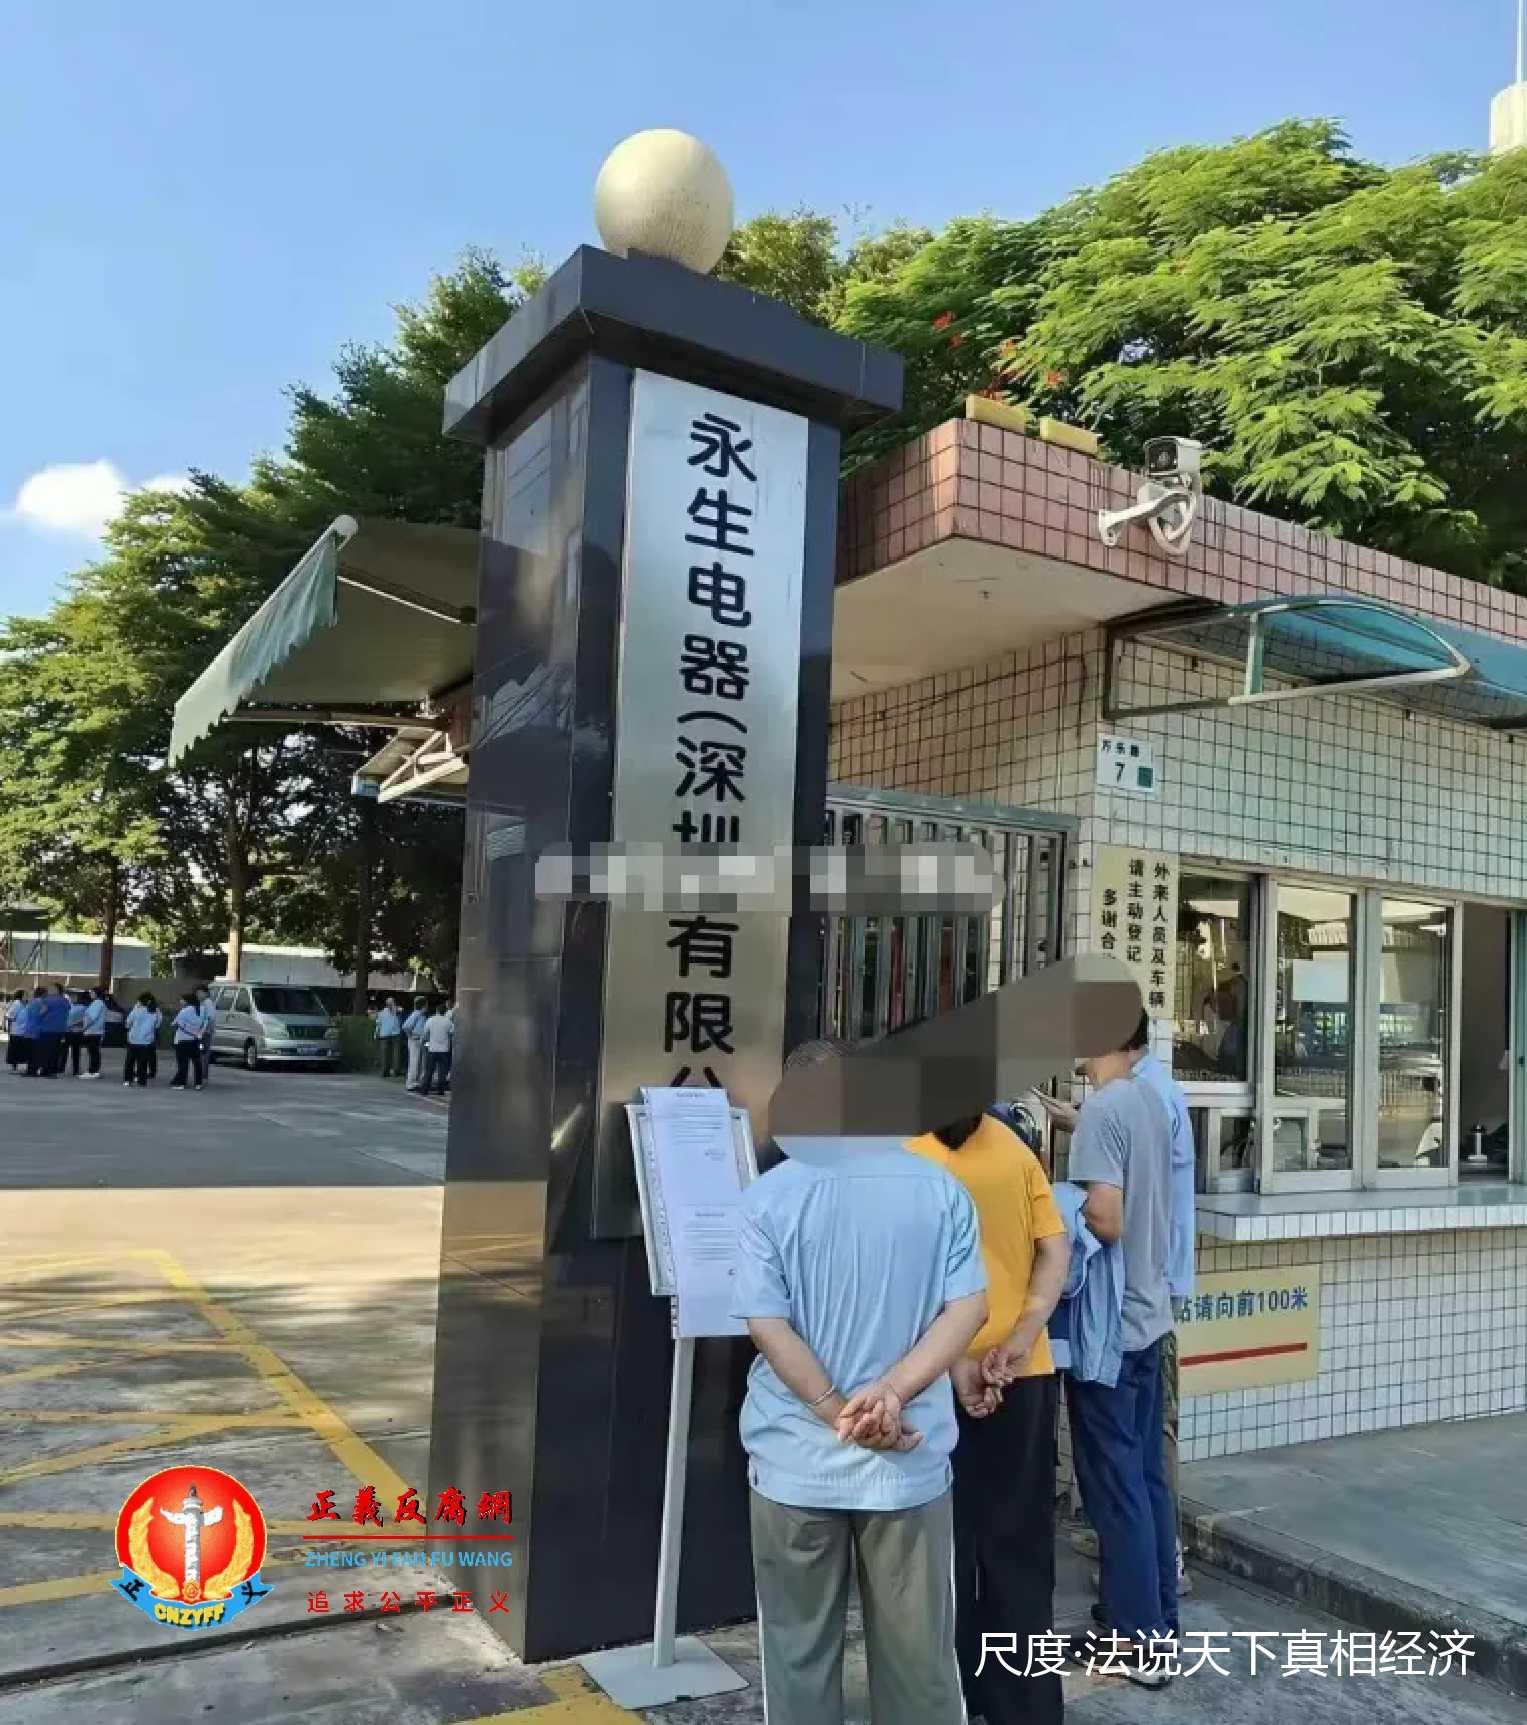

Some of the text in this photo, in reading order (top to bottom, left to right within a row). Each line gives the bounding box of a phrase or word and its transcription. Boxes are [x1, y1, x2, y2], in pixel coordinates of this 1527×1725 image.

[1114, 761, 1126, 782] 7
[1127, 858, 1145, 963] 请主动登记
[1149, 861, 1170, 1009] 外来人员及车辆
